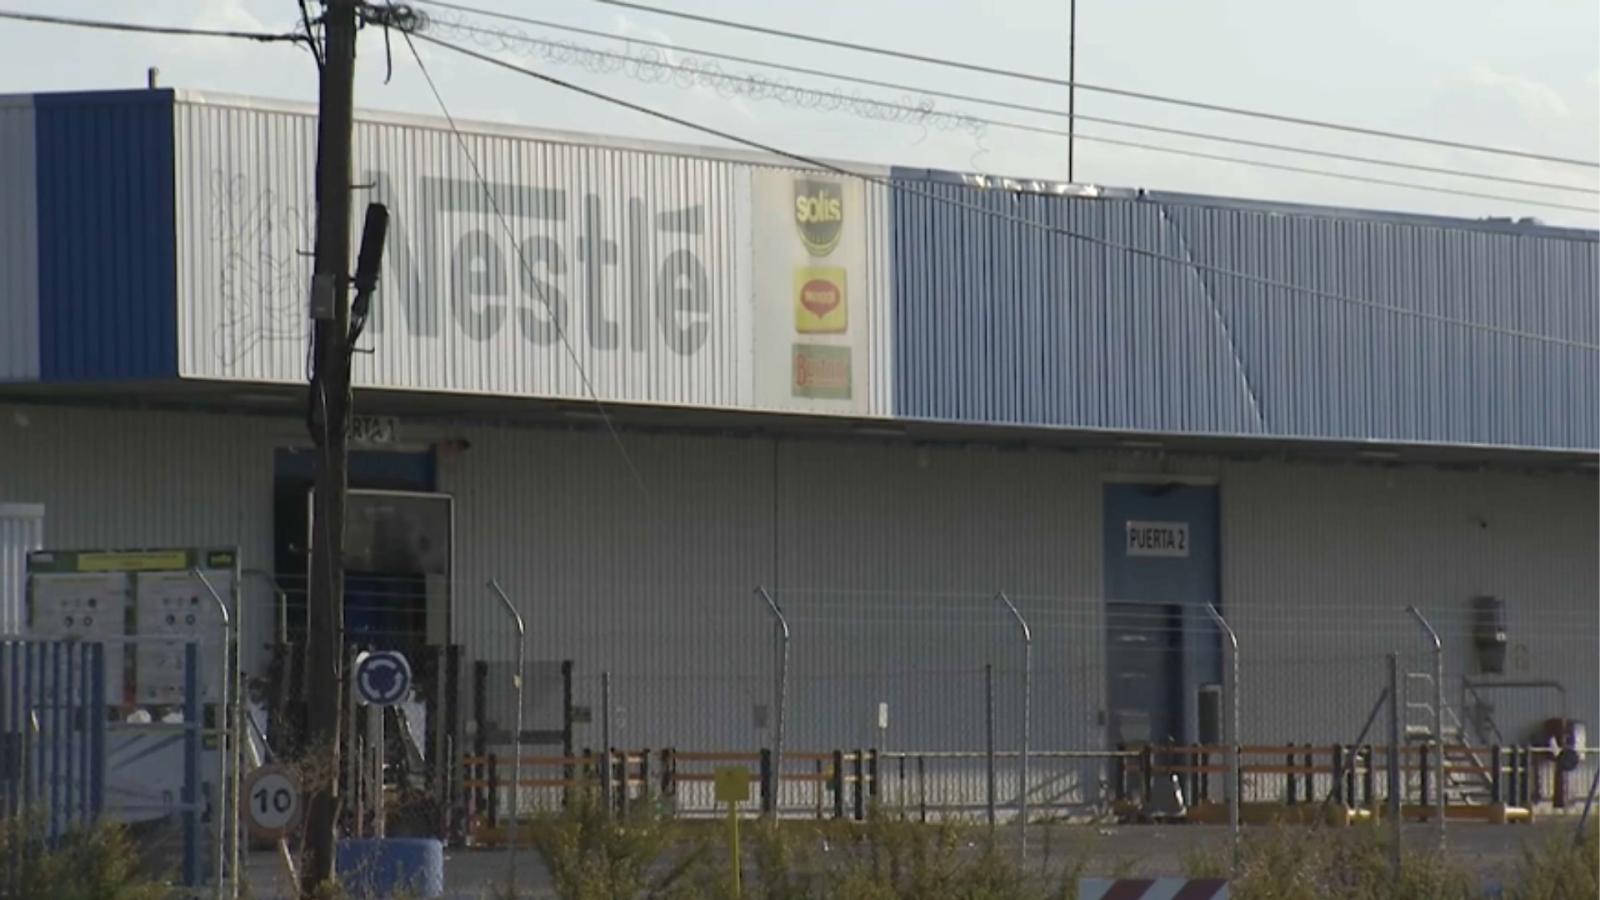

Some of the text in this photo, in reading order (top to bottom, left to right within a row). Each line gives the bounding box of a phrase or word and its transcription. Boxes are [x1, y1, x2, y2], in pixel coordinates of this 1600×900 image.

[365, 170, 714, 357] Nestlé
[1130, 527, 1185, 550] PUERTA 2
[253, 788, 292, 814] 10
